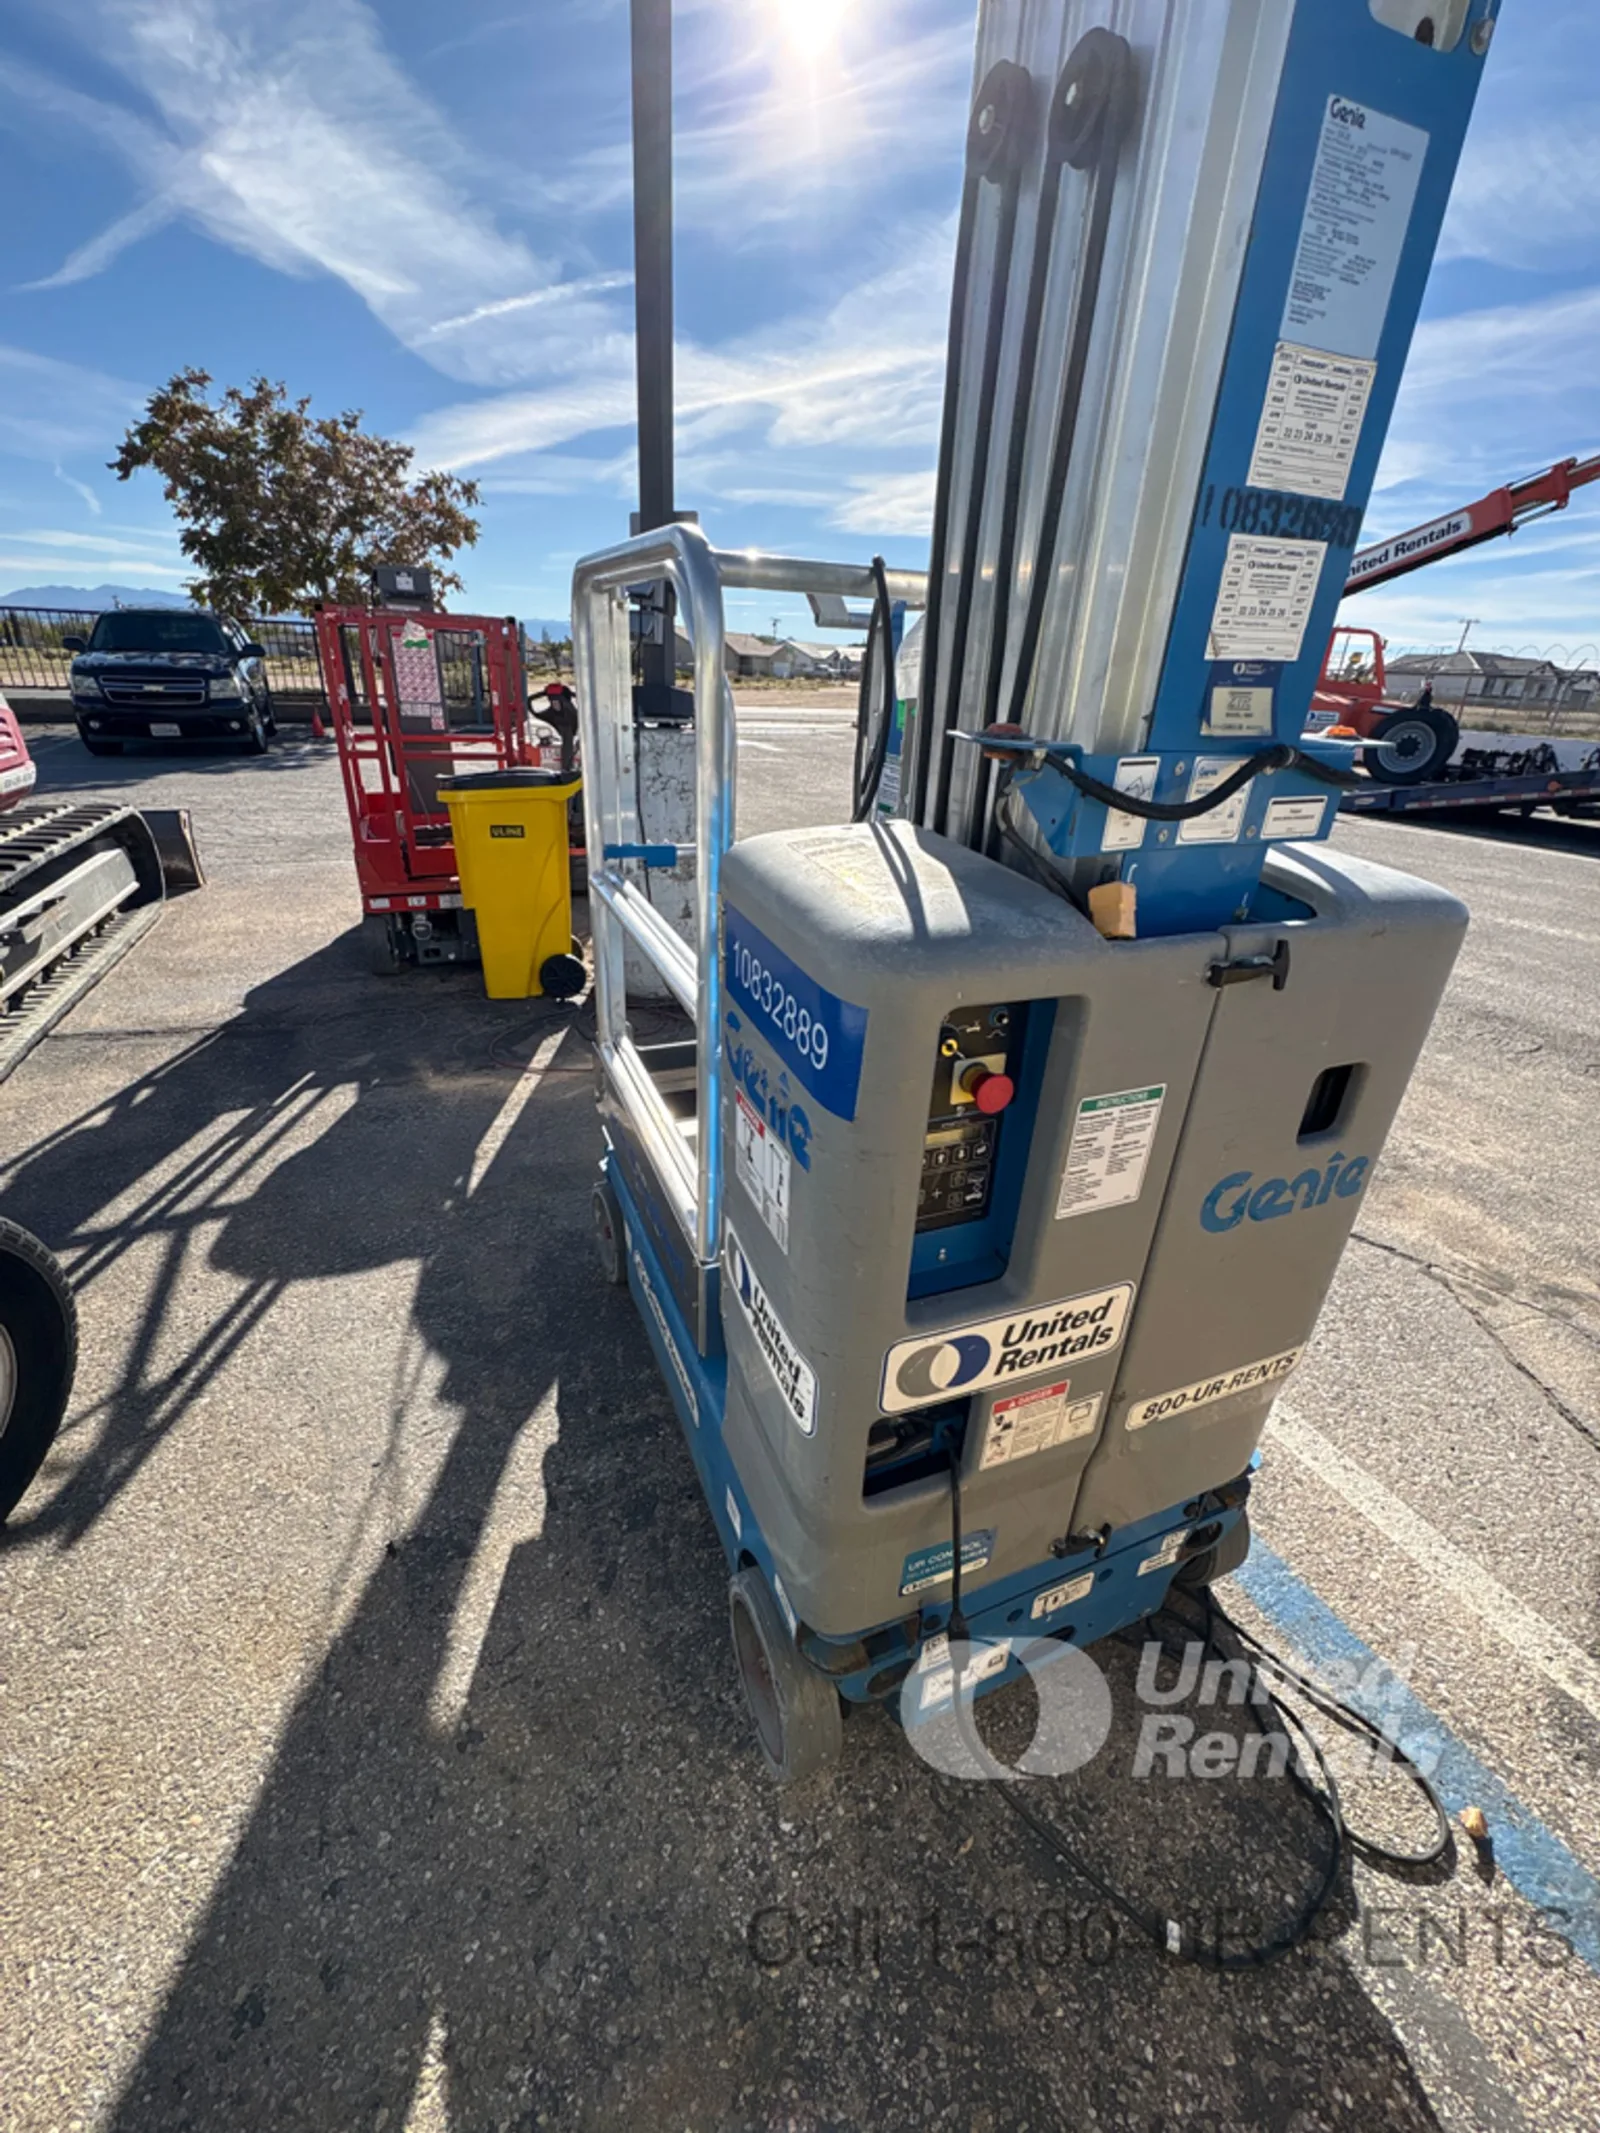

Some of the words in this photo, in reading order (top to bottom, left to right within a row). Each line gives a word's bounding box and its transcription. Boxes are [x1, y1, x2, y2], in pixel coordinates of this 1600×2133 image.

[1330, 98, 1366, 130] Genie
[1393, 519, 1465, 558] Rentals
[733, 943, 829, 1071] 10832889
[1200, 1151, 1370, 1234] Genie
[753, 1287, 801, 1383] United
[994, 1325, 1114, 1377] Rentals
[1001, 1297, 1114, 1348] United
[751, 1309, 805, 1419] Rentals
[1141, 1351, 1298, 1421] 800-UR-RENTS
